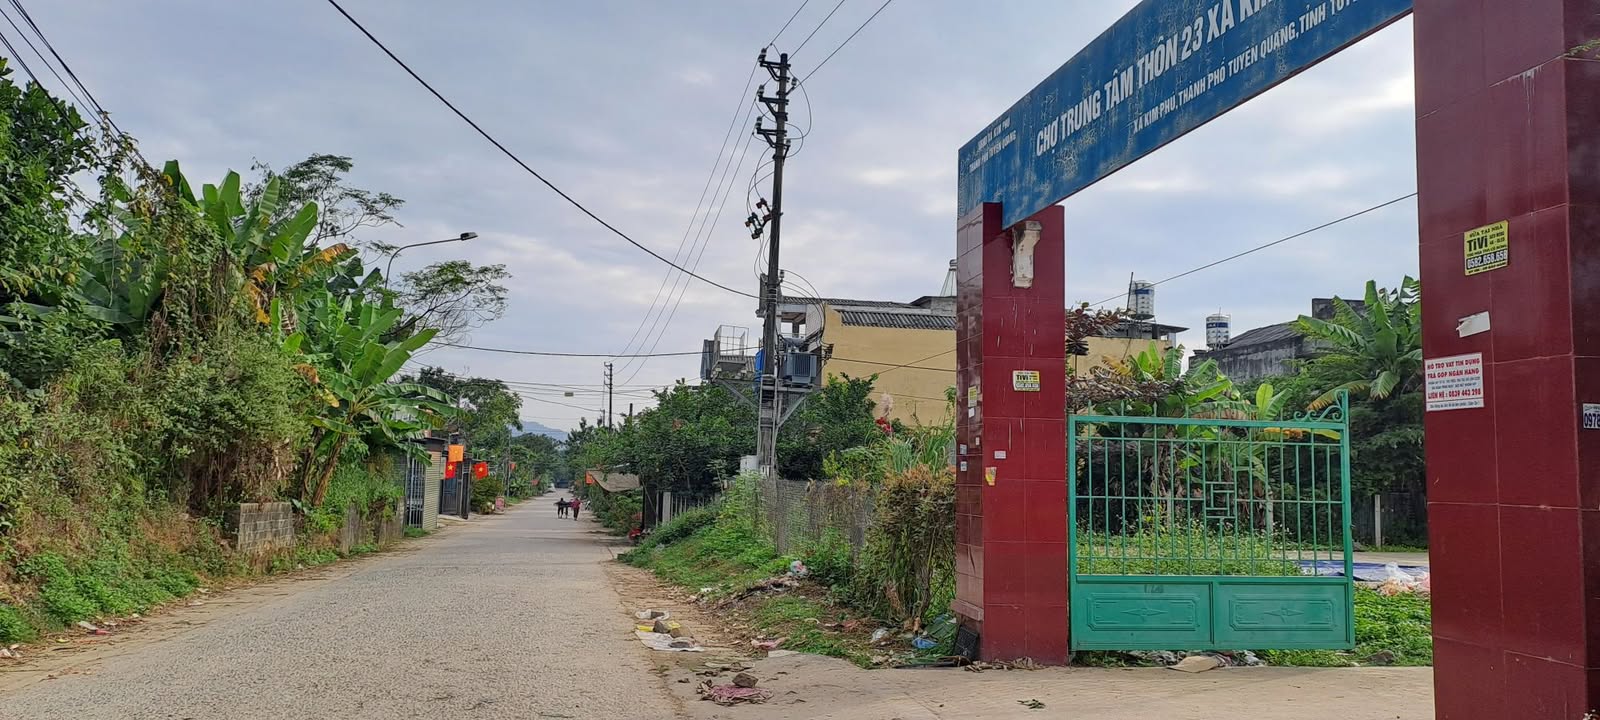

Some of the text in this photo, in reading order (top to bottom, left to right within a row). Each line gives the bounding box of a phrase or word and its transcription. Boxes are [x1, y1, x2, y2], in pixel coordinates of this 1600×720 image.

[1036, 116, 1060, 156] CHỢ
[1060, 90, 1101, 141] TRUNG
[1104, 68, 1134, 112] TÂM
[1137, 34, 1179, 89] THÔN
[1181, 16, 1204, 61] 23
[1144, 106, 1159, 127] KIM
[1178, 80, 1207, 107] THÀNH
[1207, 56, 1226, 90] PHỐ
[1228, 44, 1258, 78] TUYÊN
[1260, 21, 1300, 59] QUANG,
[1299, 4, 1327, 35] TỈNH
